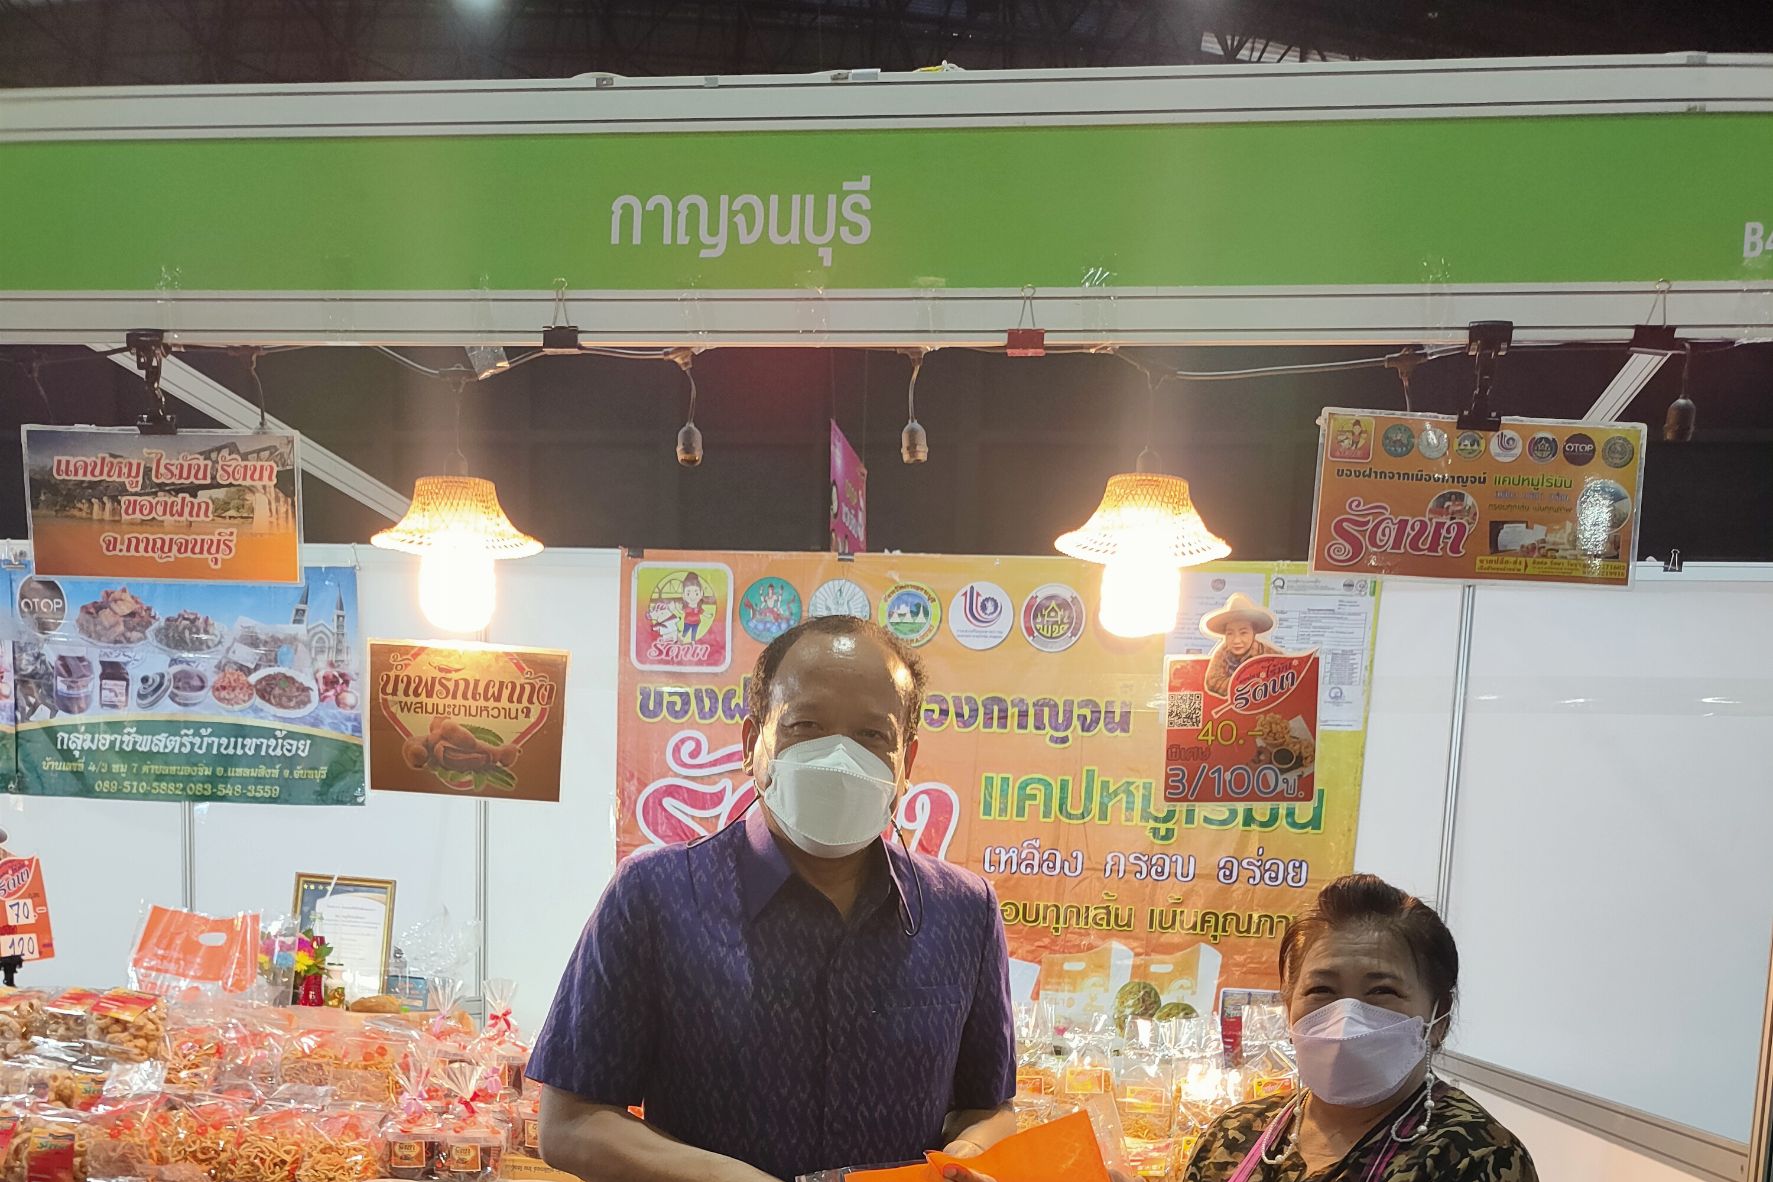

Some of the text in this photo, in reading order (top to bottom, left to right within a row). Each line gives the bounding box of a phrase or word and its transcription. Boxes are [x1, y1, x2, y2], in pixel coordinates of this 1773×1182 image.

[611, 175, 871, 267] กาญจนบุรี
[1564, 444, 1592, 453] OTOP
[217, 454, 277, 486] รัตนา
[121, 493, 212, 519] ของฝาก
[103, 529, 236, 568] จ.กาญจนบุรี
[1325, 496, 1469, 567] รัตนา
[21, 598, 63, 612] OTOP
[1234, 670, 1296, 709] รัตนา
[400, 701, 519, 720] ผสมมะขามหวาน
[56, 727, 311, 757] กลุ่มอาชีพสตรีบ้านเขาน้อย
[984, 838, 1308, 888] เหลือง กรอบ อร่อย
[998, 892, 1297, 943] อบทุกเส้น เน้นคุณภา
